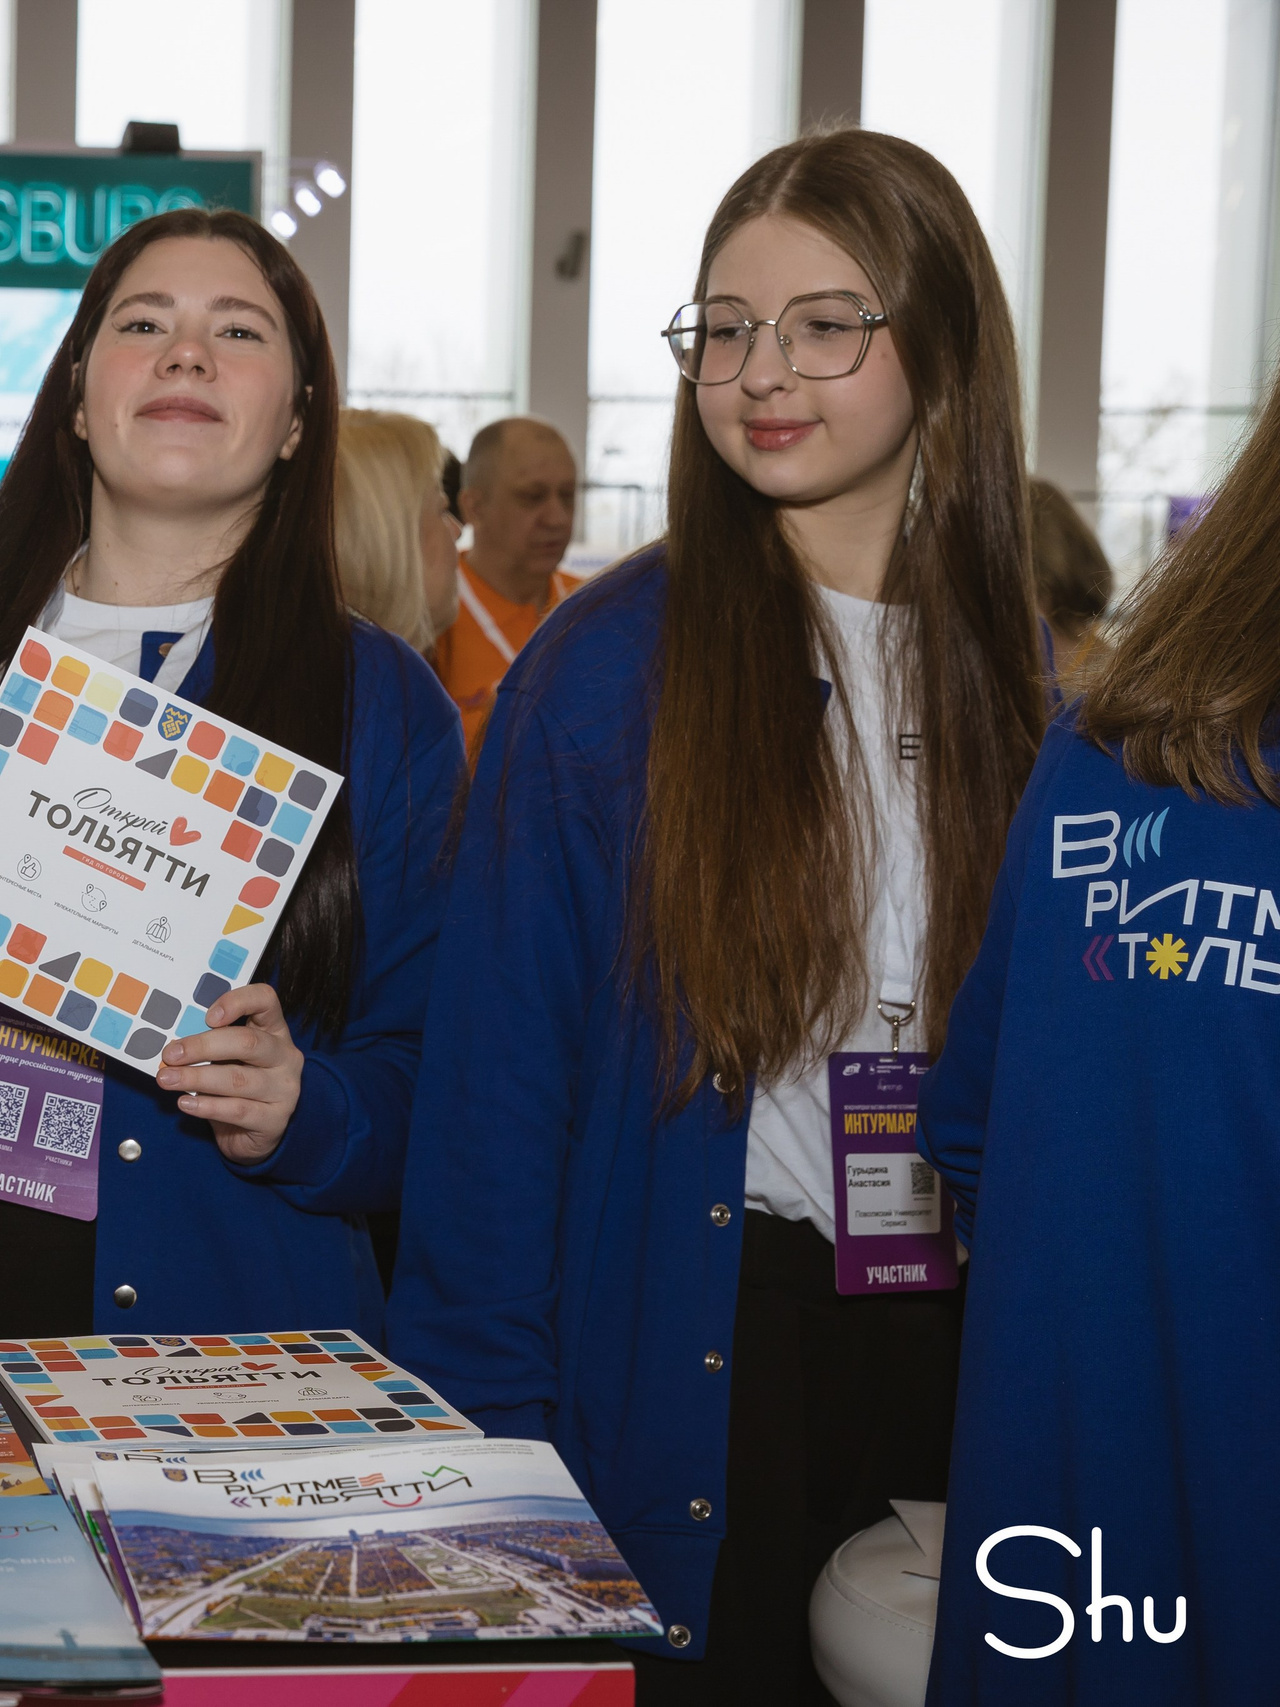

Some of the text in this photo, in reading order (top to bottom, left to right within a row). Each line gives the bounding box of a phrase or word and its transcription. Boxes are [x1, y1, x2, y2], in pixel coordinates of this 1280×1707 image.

[73, 787, 169, 836] Открой
[28, 790, 211, 898] ТОЛЬЯТТИ
[1052, 811, 1121, 878] В
[81, 856, 129, 882] ГИД ПО ГОРОДУ
[26, 888, 42, 899] МЕСТА
[53, 901, 119, 935] УВЛЕКАТЕЛЬНЫЕ МАРШРУТЫ
[131, 939, 174, 962] ДЕТАЛЬНАЯ КАРТА
[18, 1058, 67, 1076] российского
[66, 1070, 104, 1084] туризма
[843, 1112, 917, 1134] ИНТУРМАР
[848, 1179, 891, 1188] Анастасия
[866, 1264, 928, 1284] УЧАСТНИК
[92, 1370, 323, 1387] ТОЛЬЯТТИ
[134, 1365, 243, 1378] Открой
[193, 1469, 238, 1484] В
[224, 1476, 360, 1496] РИТМЕ
